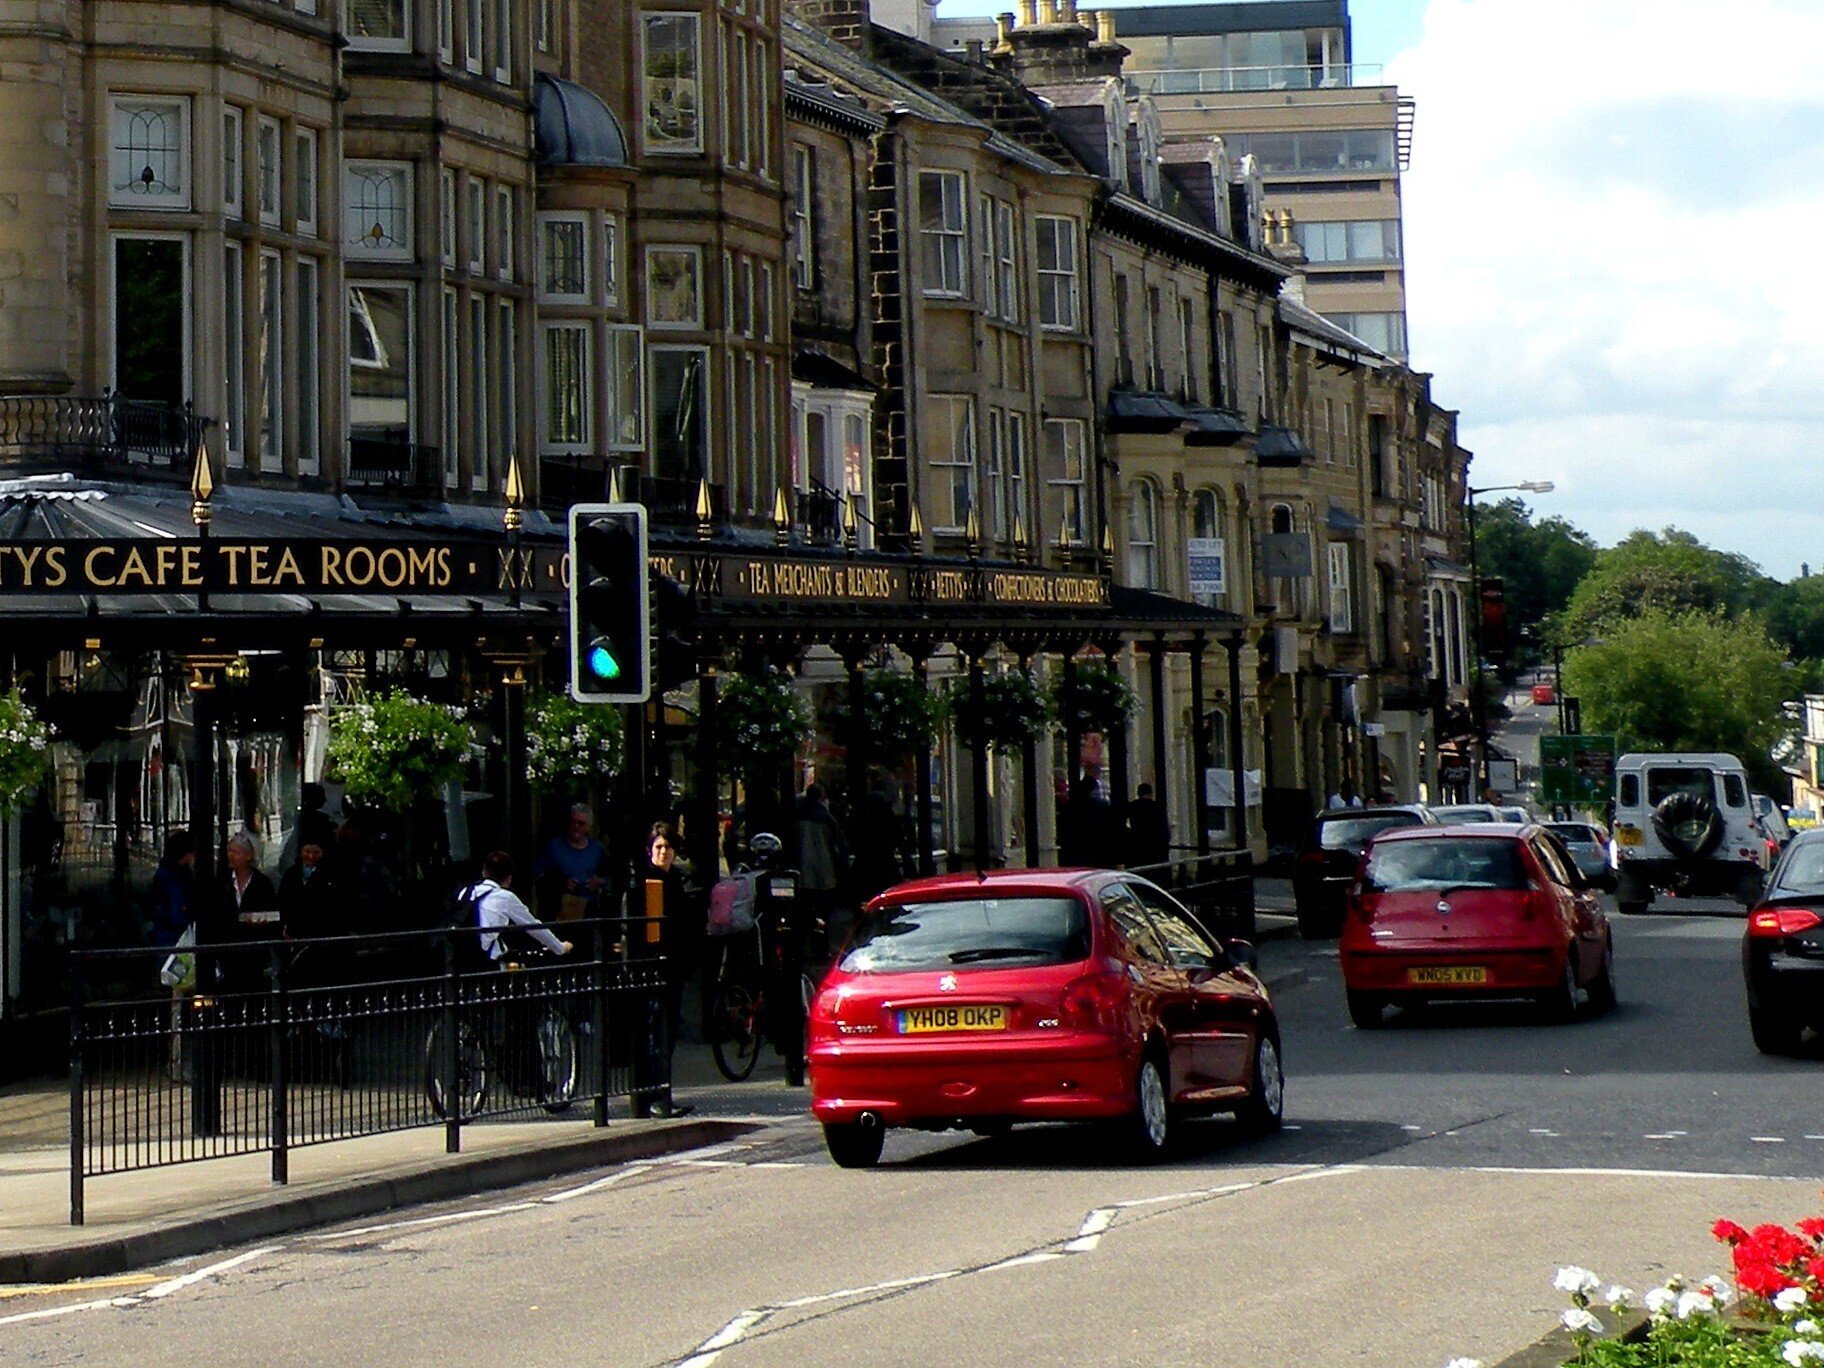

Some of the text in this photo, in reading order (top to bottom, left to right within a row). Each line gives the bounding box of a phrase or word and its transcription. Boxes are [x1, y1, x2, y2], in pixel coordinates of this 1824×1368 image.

[84, 545, 203, 585] CAFE
[219, 546, 306, 586] TEA
[322, 547, 452, 587] ROOMS
[748, 562, 770, 594] TEA
[774, 563, 832, 596] MERCHANTS
[847, 566, 890, 597] BLENDERS
[909, 1007, 1001, 1029] YH08 OKP
